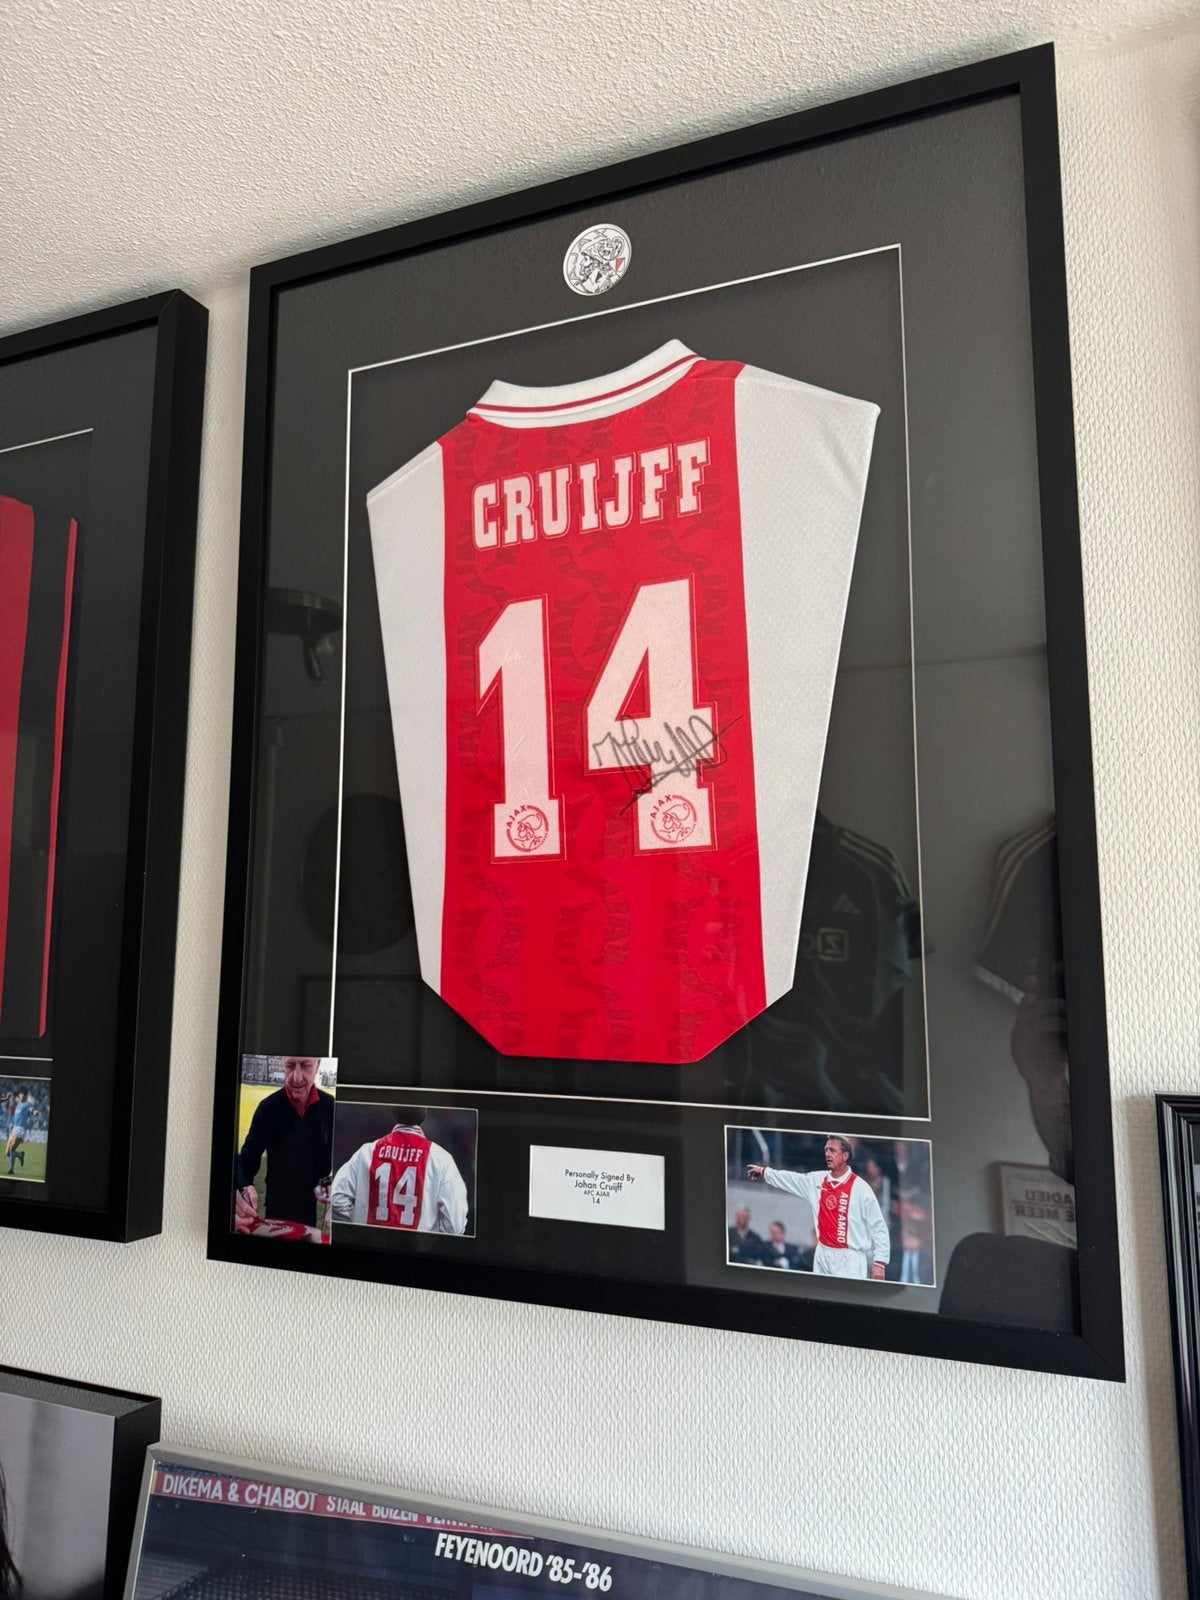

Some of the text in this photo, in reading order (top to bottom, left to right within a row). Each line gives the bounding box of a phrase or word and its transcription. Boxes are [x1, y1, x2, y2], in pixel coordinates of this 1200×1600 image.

[472, 438, 709, 550] CRUIJFF
[475, 576, 718, 862] 14
[506, 804, 527, 828] AJAX
[650, 794, 672, 819] AJAX
[378, 1144, 423, 1163] CRUIJFF
[565, 1169, 636, 1184] Personally Signed By
[574, 1180, 597, 1189] Johan
[374, 1162, 418, 1226] 14
[162, 1474, 223, 1500] DIKEMA
[228, 1482, 240, 1502] &
[245, 1484, 318, 1511] CHABOT
[327, 1495, 366, 1516] STAAL
[434, 1532, 544, 1577] FEYENOORD
